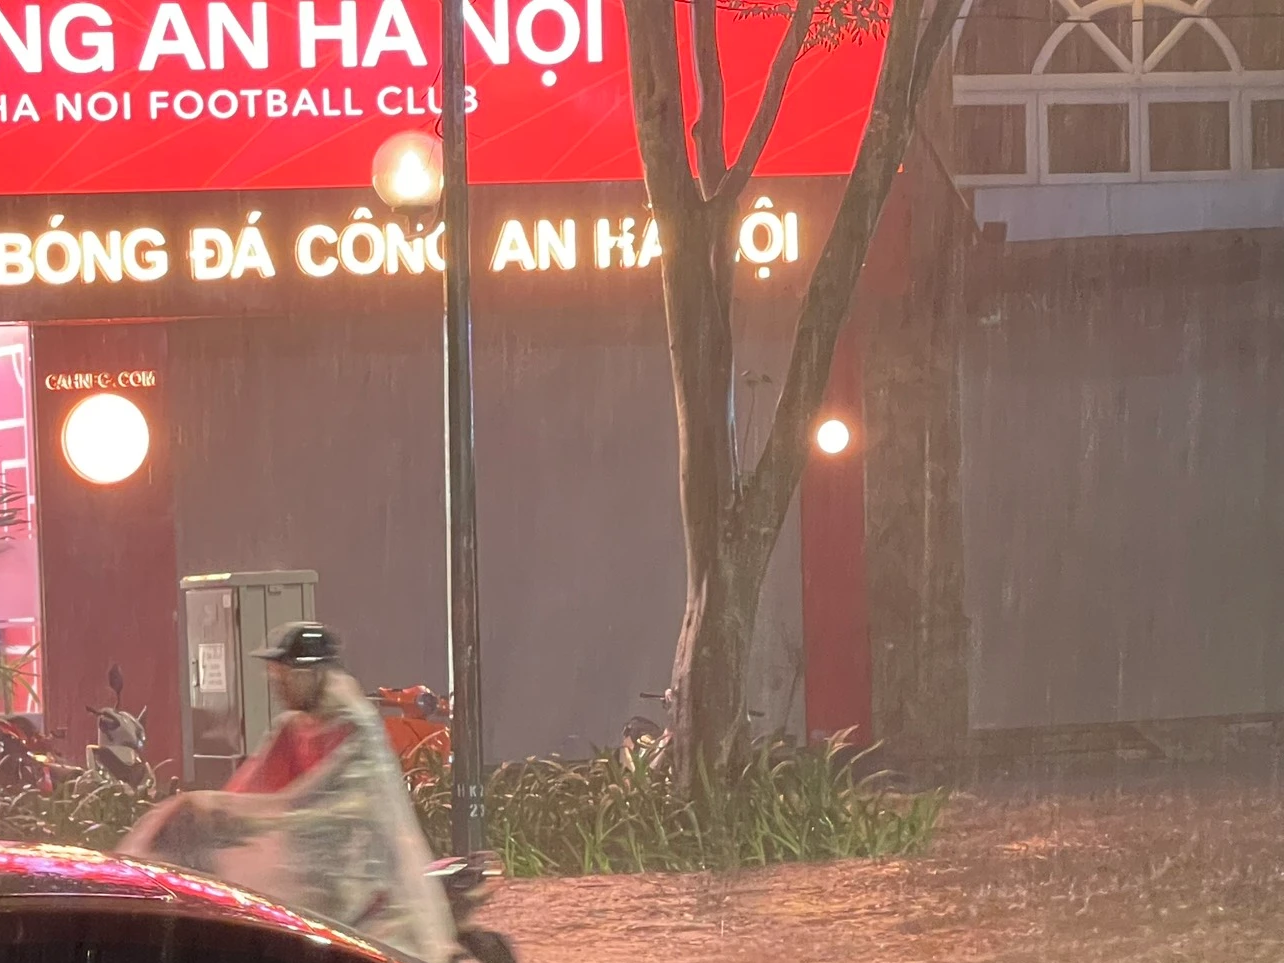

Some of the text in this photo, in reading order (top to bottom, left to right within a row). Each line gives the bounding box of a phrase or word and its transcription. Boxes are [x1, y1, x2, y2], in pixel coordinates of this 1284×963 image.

[138, 2, 269, 71] AN
[55, 91, 131, 121] NOI
[149, 87, 363, 120] FOOTBALL
[190, 210, 276, 280] ĐÁ
[489, 218, 576, 272] AN
[735, 196, 799, 279] ỘI
